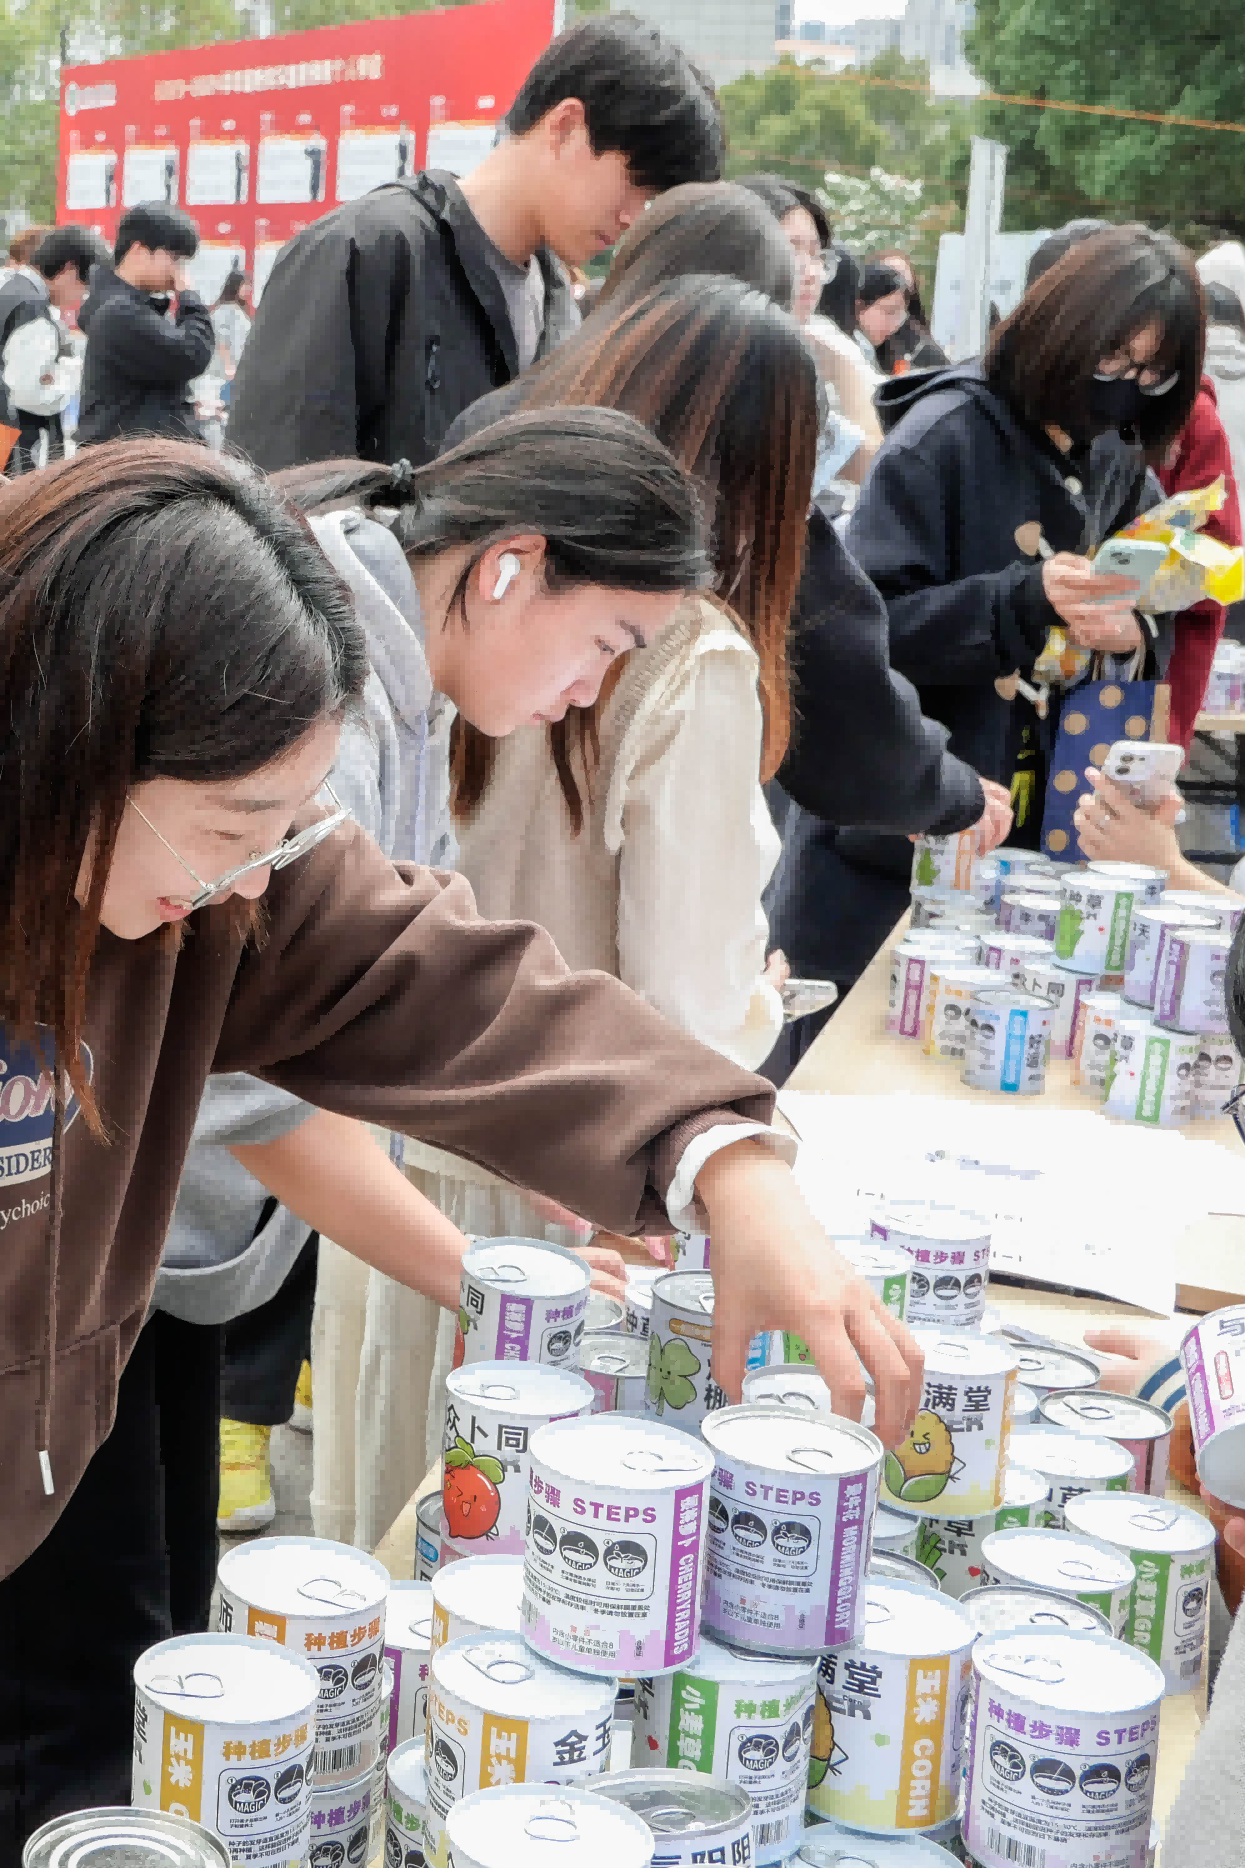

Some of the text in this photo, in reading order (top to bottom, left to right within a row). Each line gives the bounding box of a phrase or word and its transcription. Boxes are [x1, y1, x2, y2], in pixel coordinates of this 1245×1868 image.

[924, 1381, 992, 1412] 满堂
[529, 1466, 657, 1524] 步骤 STEPS
[711, 1466, 822, 1507] 骤 STEPS
[778, 1546, 805, 1557] MAGIC
[610, 1567, 639, 1579] MAGIC
[304, 1615, 381, 1652] 种植步骤
[429, 1694, 469, 1736] TEPS
[842, 1694, 863, 1706] Corn
[987, 1697, 1081, 1748] 种植步骤
[167, 1724, 194, 1788] 玉米
[222, 1722, 308, 1762] 种植步骤
[907, 1669, 941, 1817] 玉米 CORN
[744, 1757, 774, 1770] MAGIC
[236, 1801, 264, 1812] MAGIC
